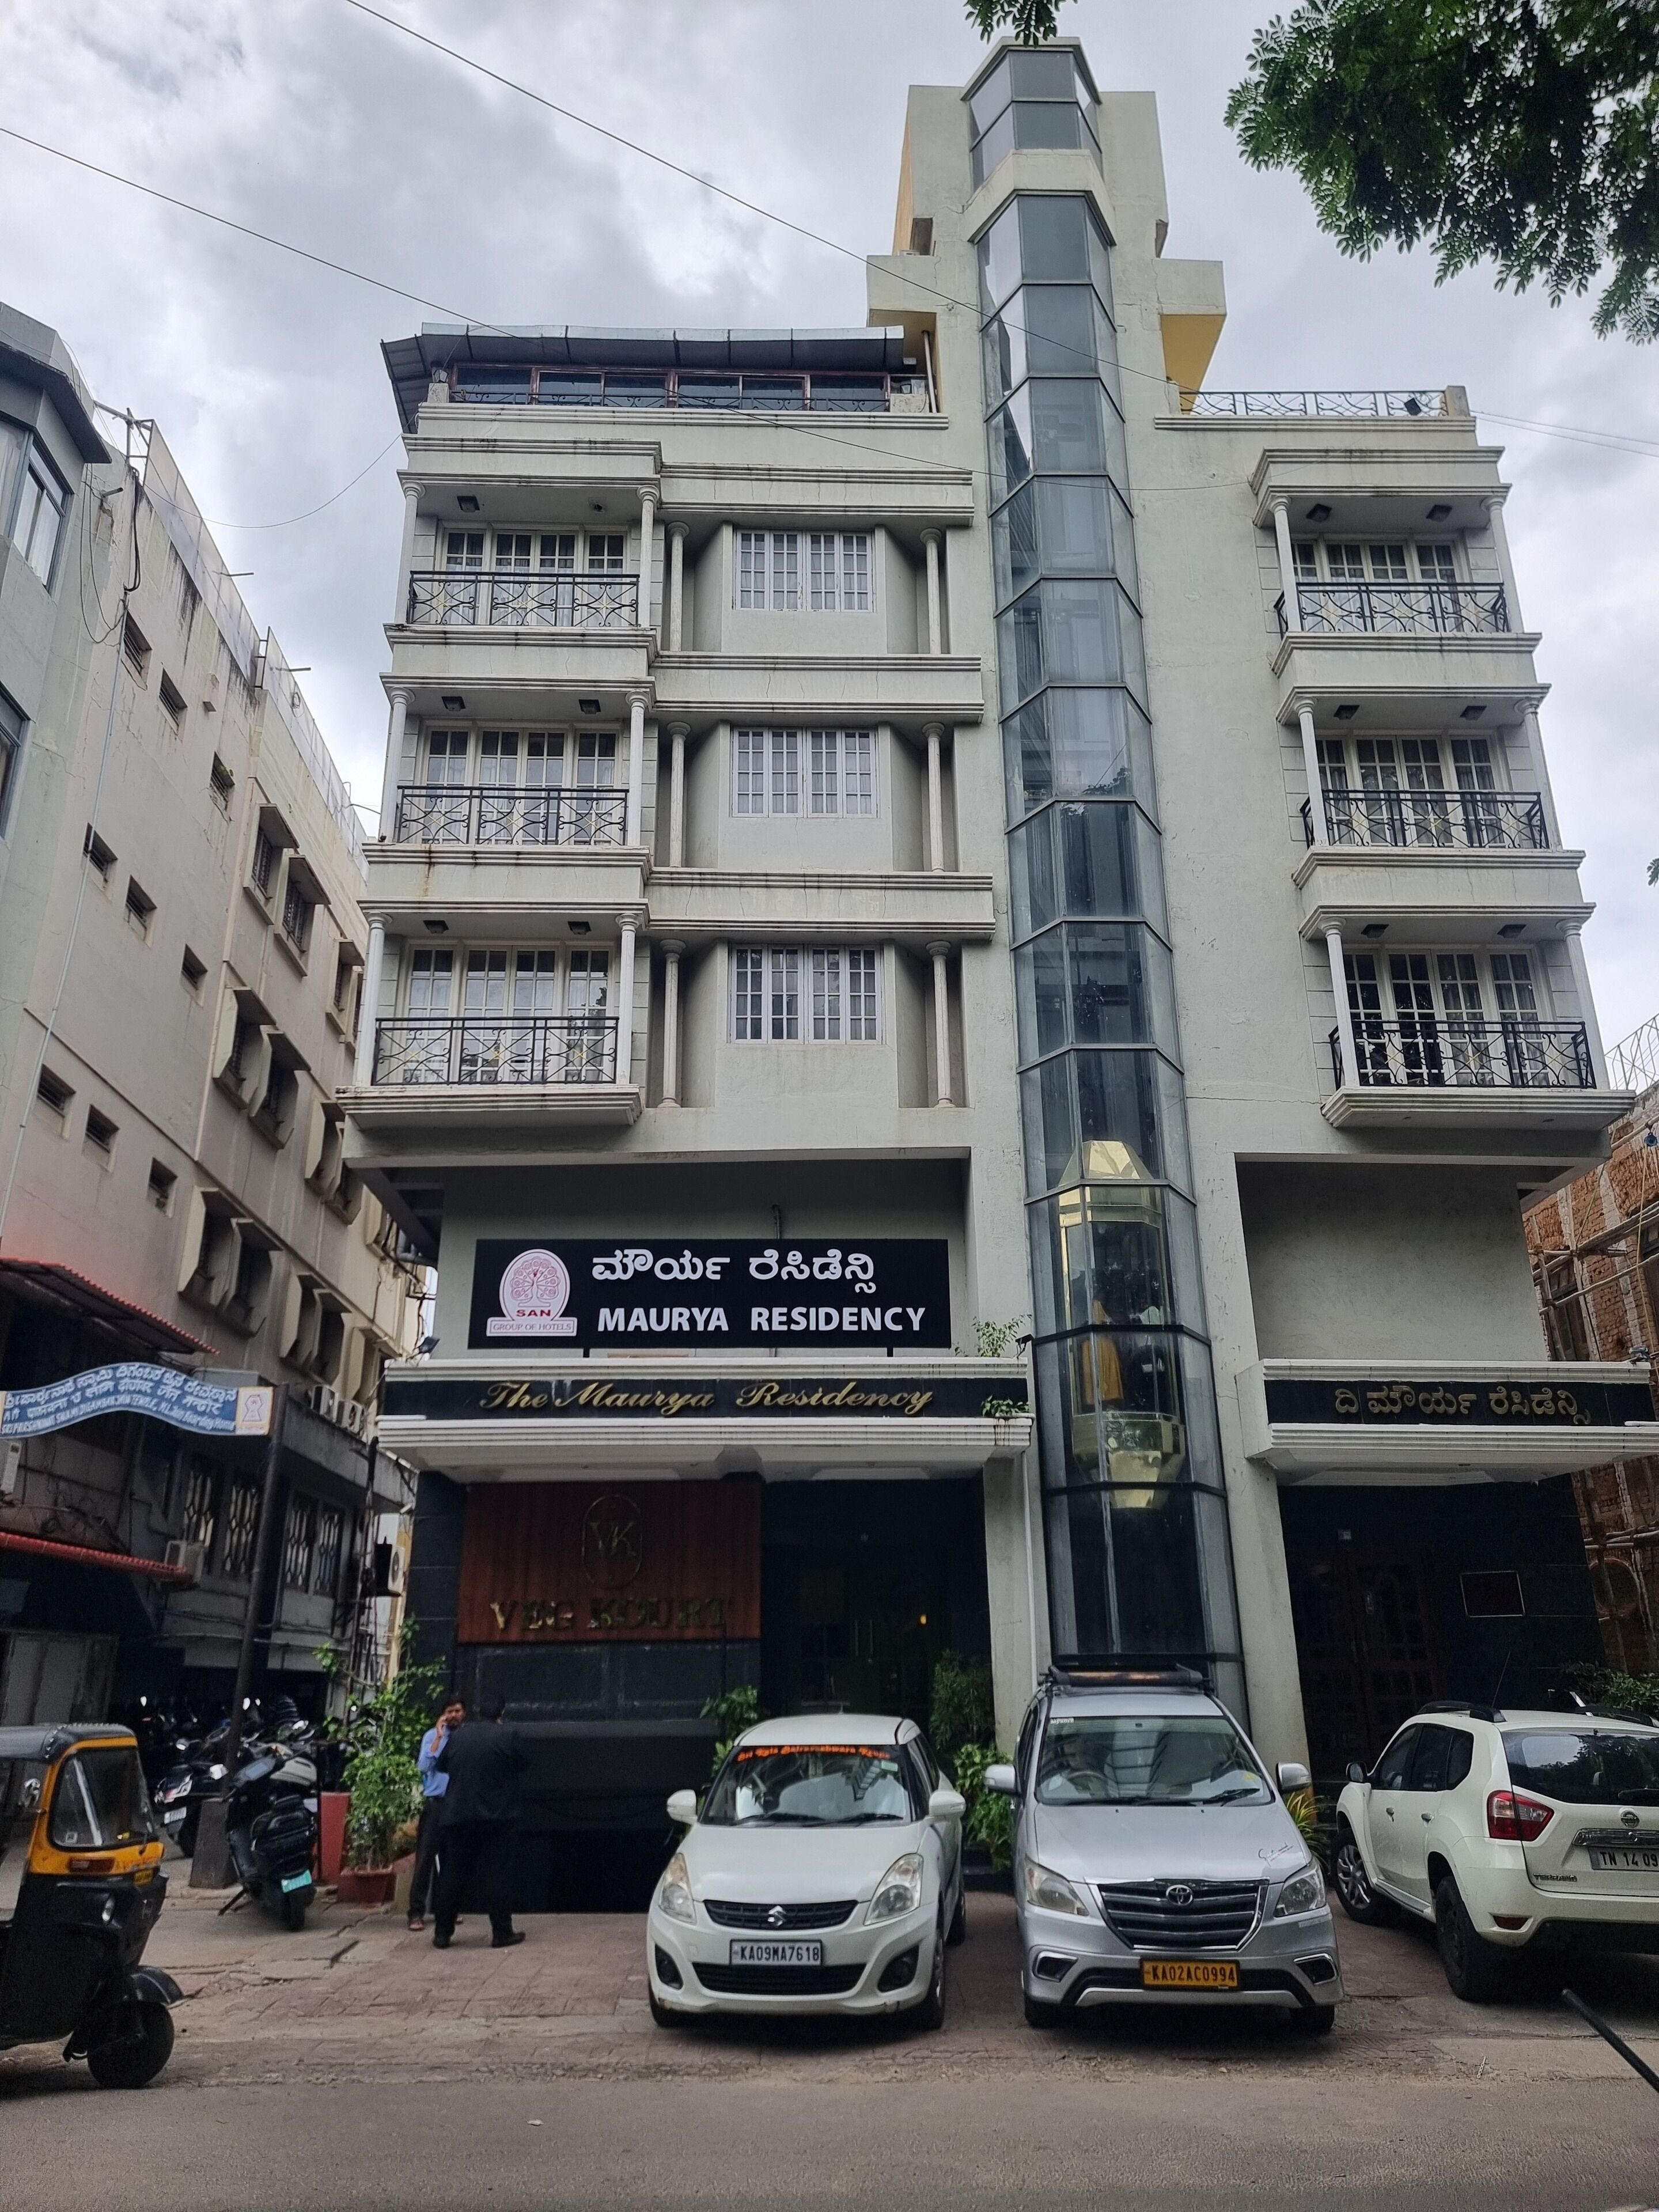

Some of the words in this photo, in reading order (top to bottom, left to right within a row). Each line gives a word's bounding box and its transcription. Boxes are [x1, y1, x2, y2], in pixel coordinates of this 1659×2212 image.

[592, 1249, 730, 1280] ಮೌರ್ಯ
[749, 1249, 876, 1294] ರೆಸಿಡೆನ್ಸಿ
[597, 1307, 729, 1332] MAURYA
[751, 1306, 926, 1331] RESIDENCY
[480, 1382, 548, 1409] The
[555, 1381, 714, 1415] Maurya
[736, 1381, 933, 1415] Residency
[1335, 1388, 1360, 1413] ದಿ
[1367, 1385, 1478, 1415] ಮೌರ್ಯ
[1489, 1386, 1592, 1425] ರೆಸಿಡೆನ್ಸಿ
[490, 1599, 575, 1630] VEG
[588, 1597, 727, 1628] KOURT
[1600, 1851, 1617, 1866] TN
[1623, 1852, 1638, 1866] 14
[740, 1945, 820, 1961] KA09MA7618
[1152, 1965, 1236, 1982] KA02AC0994
